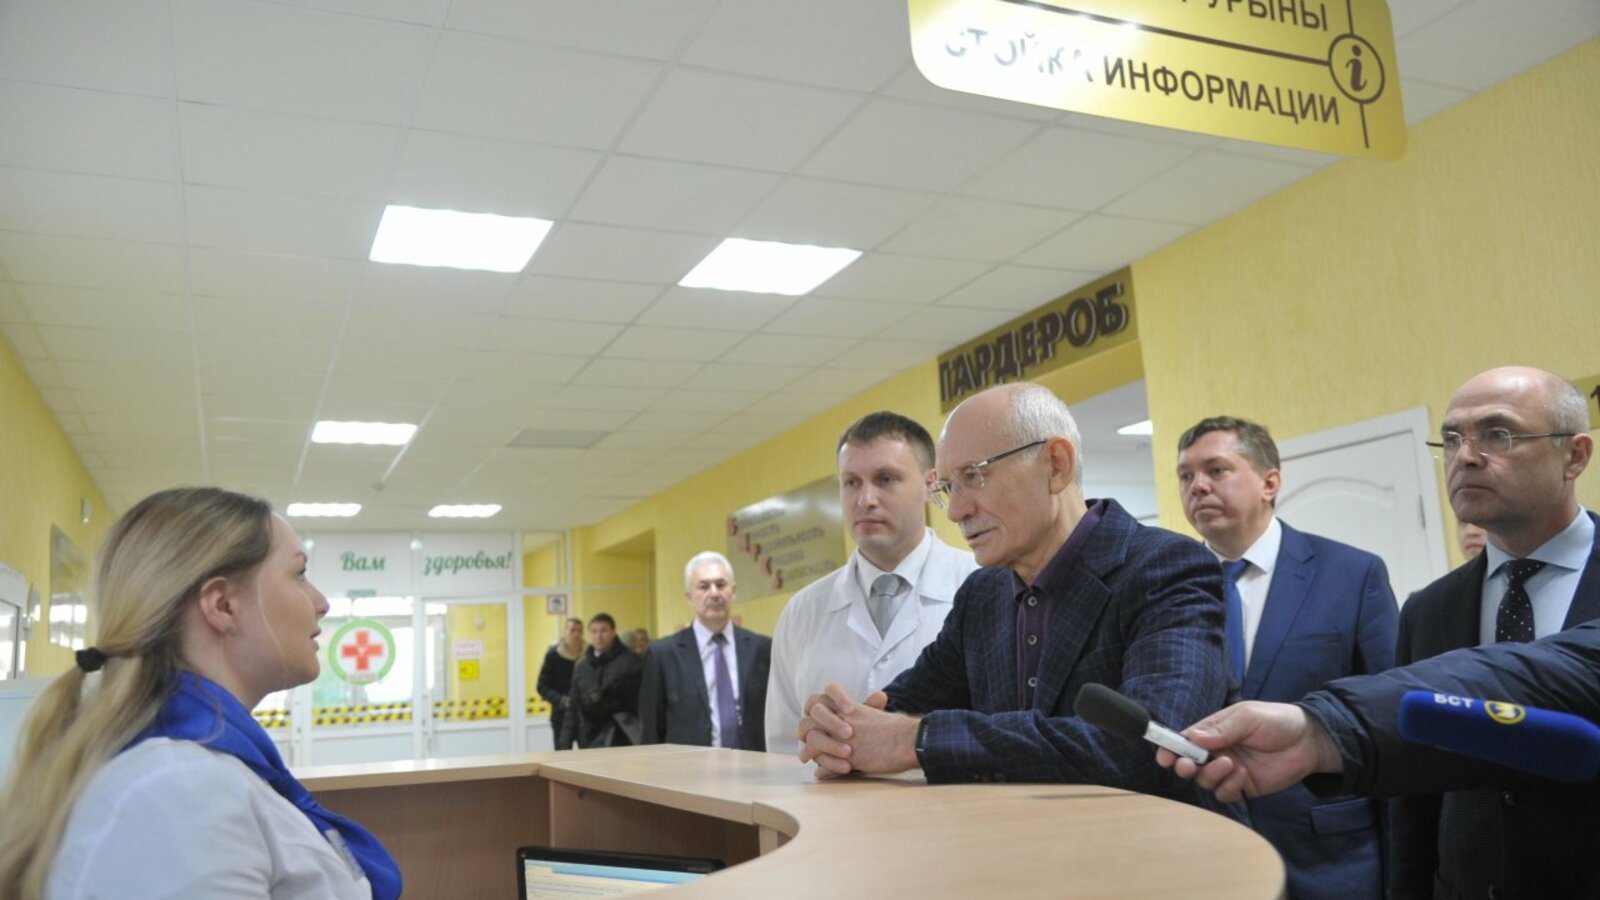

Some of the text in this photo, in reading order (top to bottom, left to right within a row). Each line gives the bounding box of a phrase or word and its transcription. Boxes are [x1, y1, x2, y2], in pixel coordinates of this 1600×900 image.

[1103, 54, 1340, 126] ИНФОРМАЦИИ
[939, 280, 1129, 403] ГАРДЕРОБ
[340, 550, 513, 576] Вам здоровья!
[1433, 693, 1474, 708] БСТ
